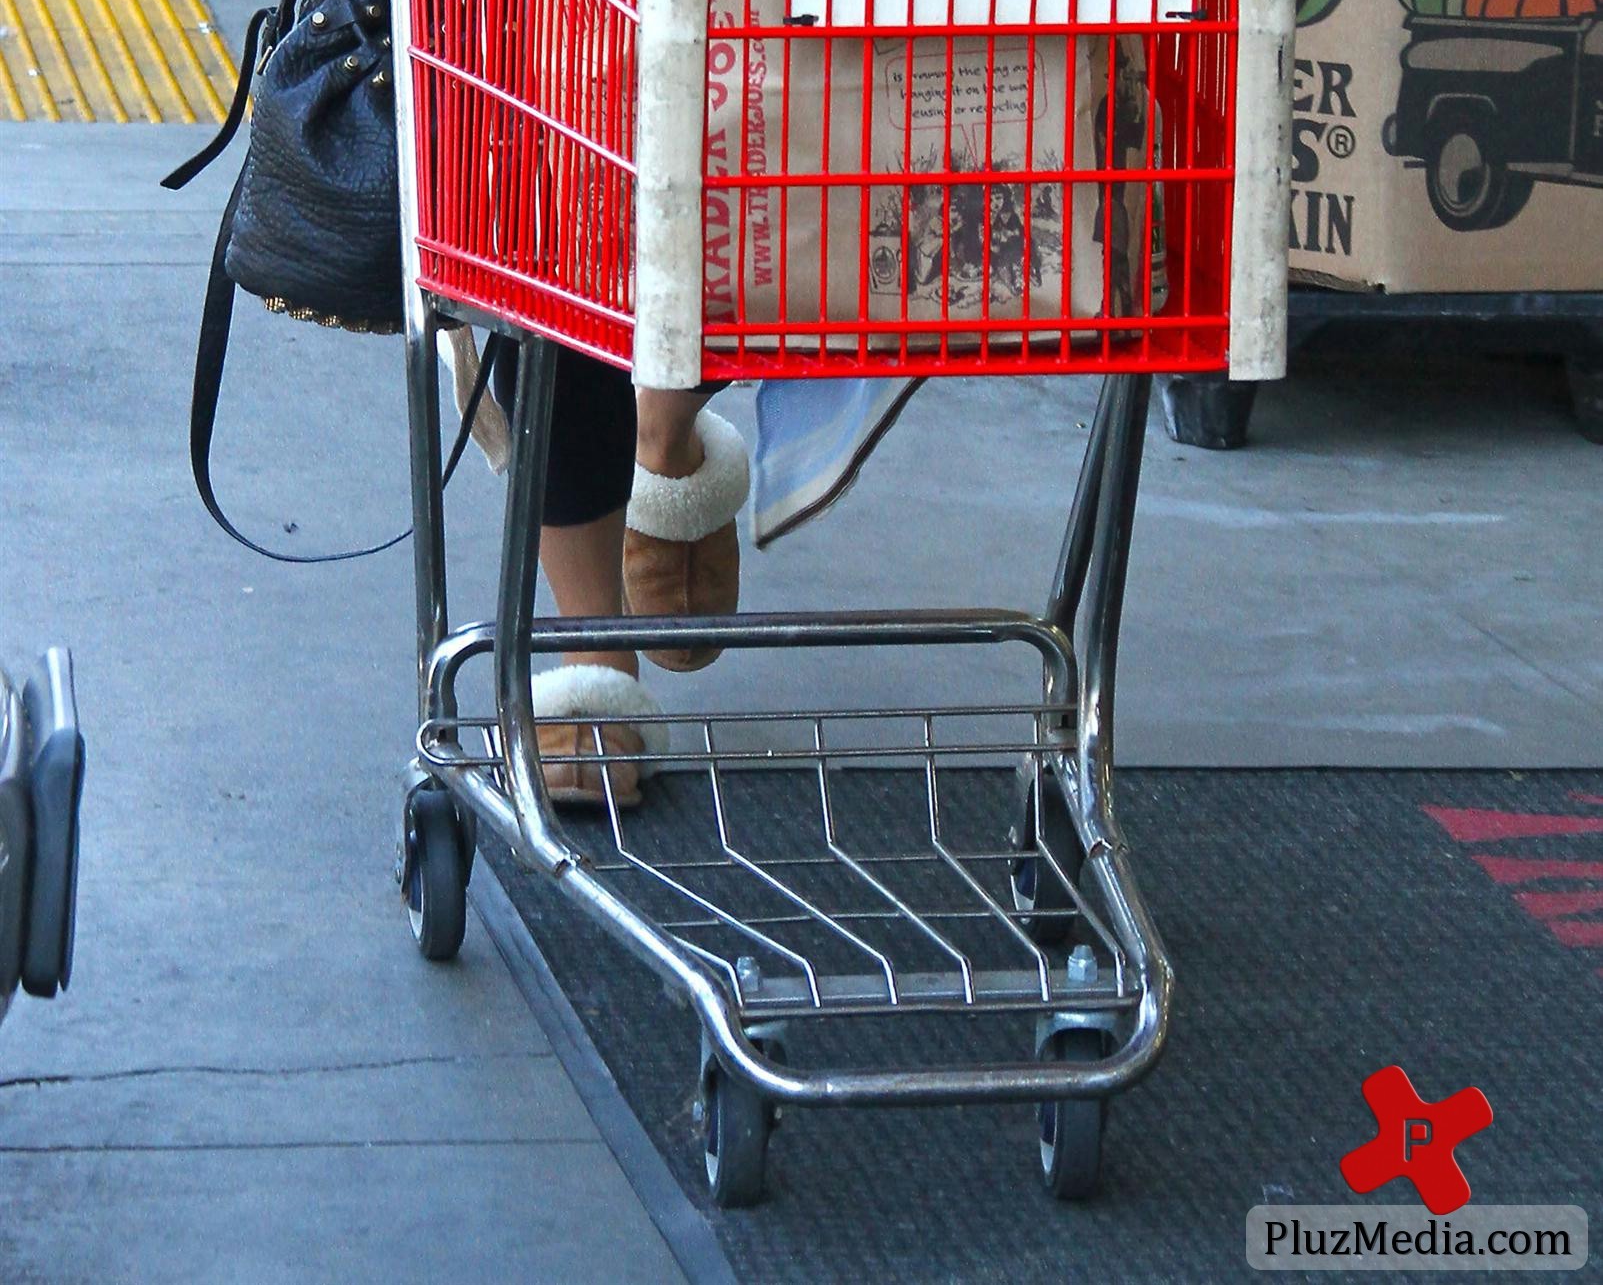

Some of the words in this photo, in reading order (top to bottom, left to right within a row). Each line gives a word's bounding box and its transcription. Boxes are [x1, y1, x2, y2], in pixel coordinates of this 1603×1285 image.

[958, 66, 981, 77] the
[984, 65, 1010, 78] ag
[966, 87, 980, 95] on
[954, 106, 965, 115] or
